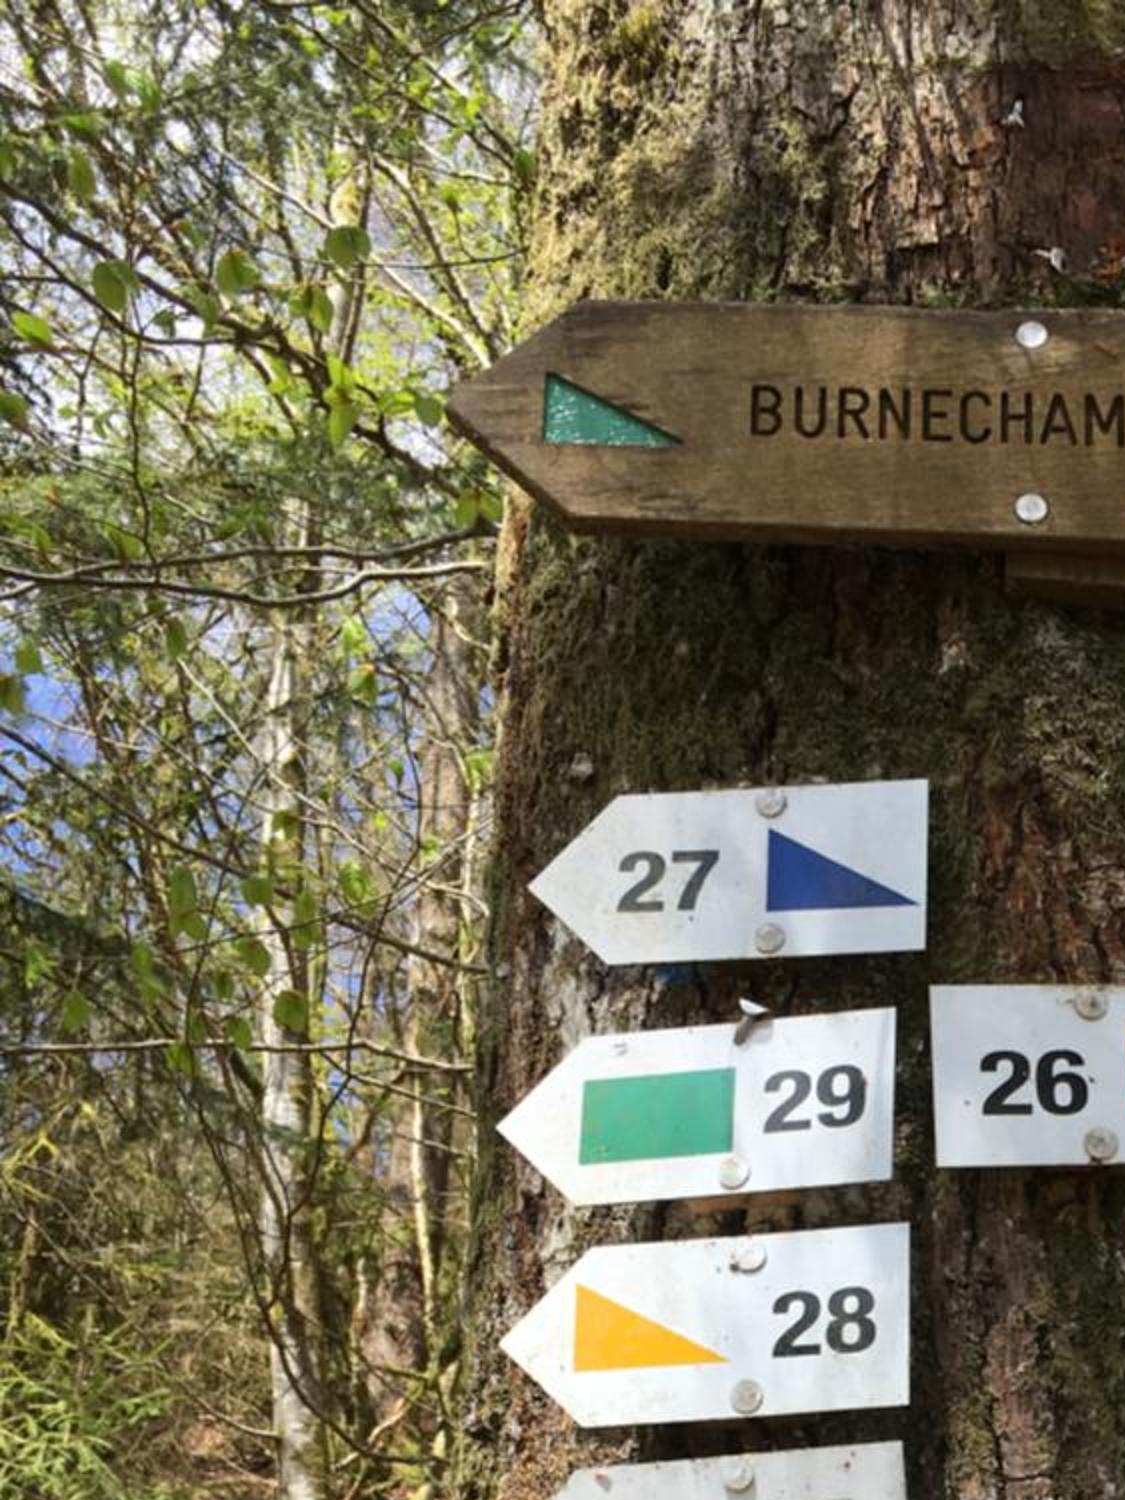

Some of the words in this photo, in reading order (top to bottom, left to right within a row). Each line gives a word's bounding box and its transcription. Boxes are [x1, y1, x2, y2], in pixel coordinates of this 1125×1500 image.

[616, 849, 721, 914] 27
[762, 1063, 868, 1133] 29
[978, 1048, 1090, 1117] 26
[770, 1286, 878, 1359] 28
